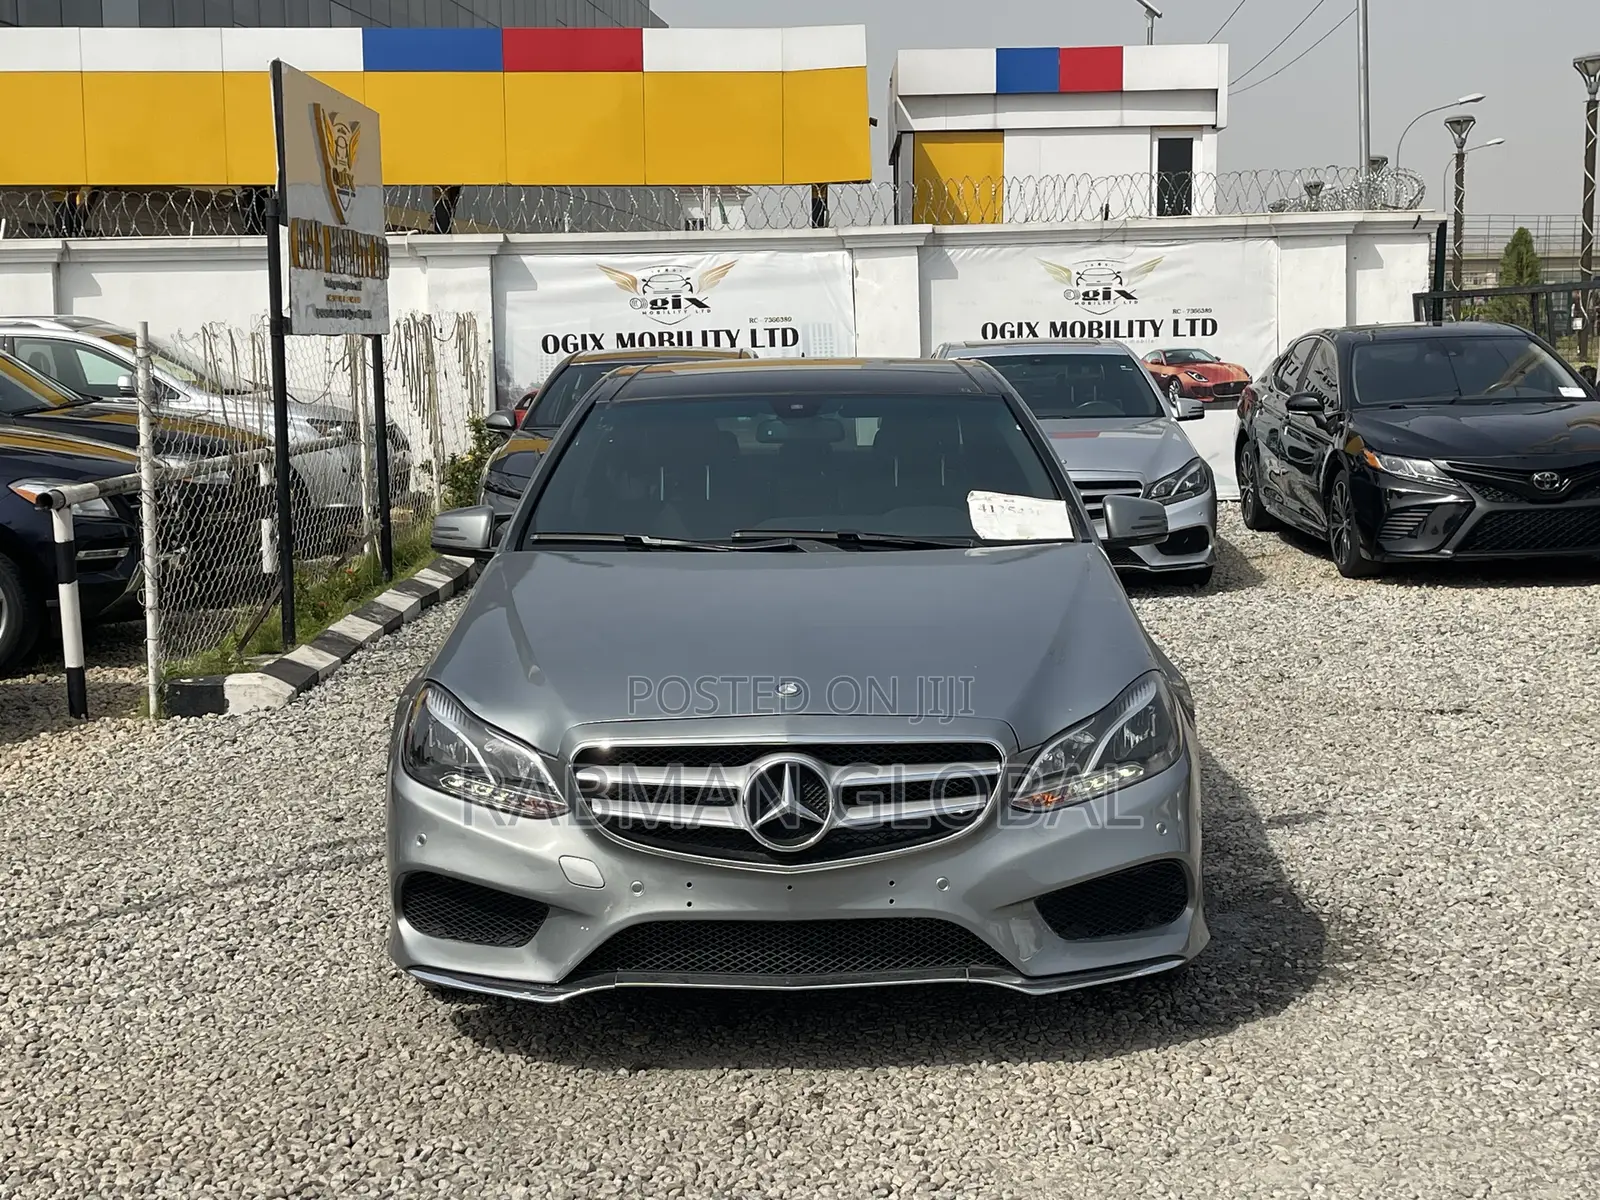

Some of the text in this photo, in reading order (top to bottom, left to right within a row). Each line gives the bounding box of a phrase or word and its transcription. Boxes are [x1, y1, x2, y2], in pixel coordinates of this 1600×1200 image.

[541, 327, 799, 354] OGIX MOBILITY LTD
[981, 317, 1218, 340] OGIX MOBILITY LTD
